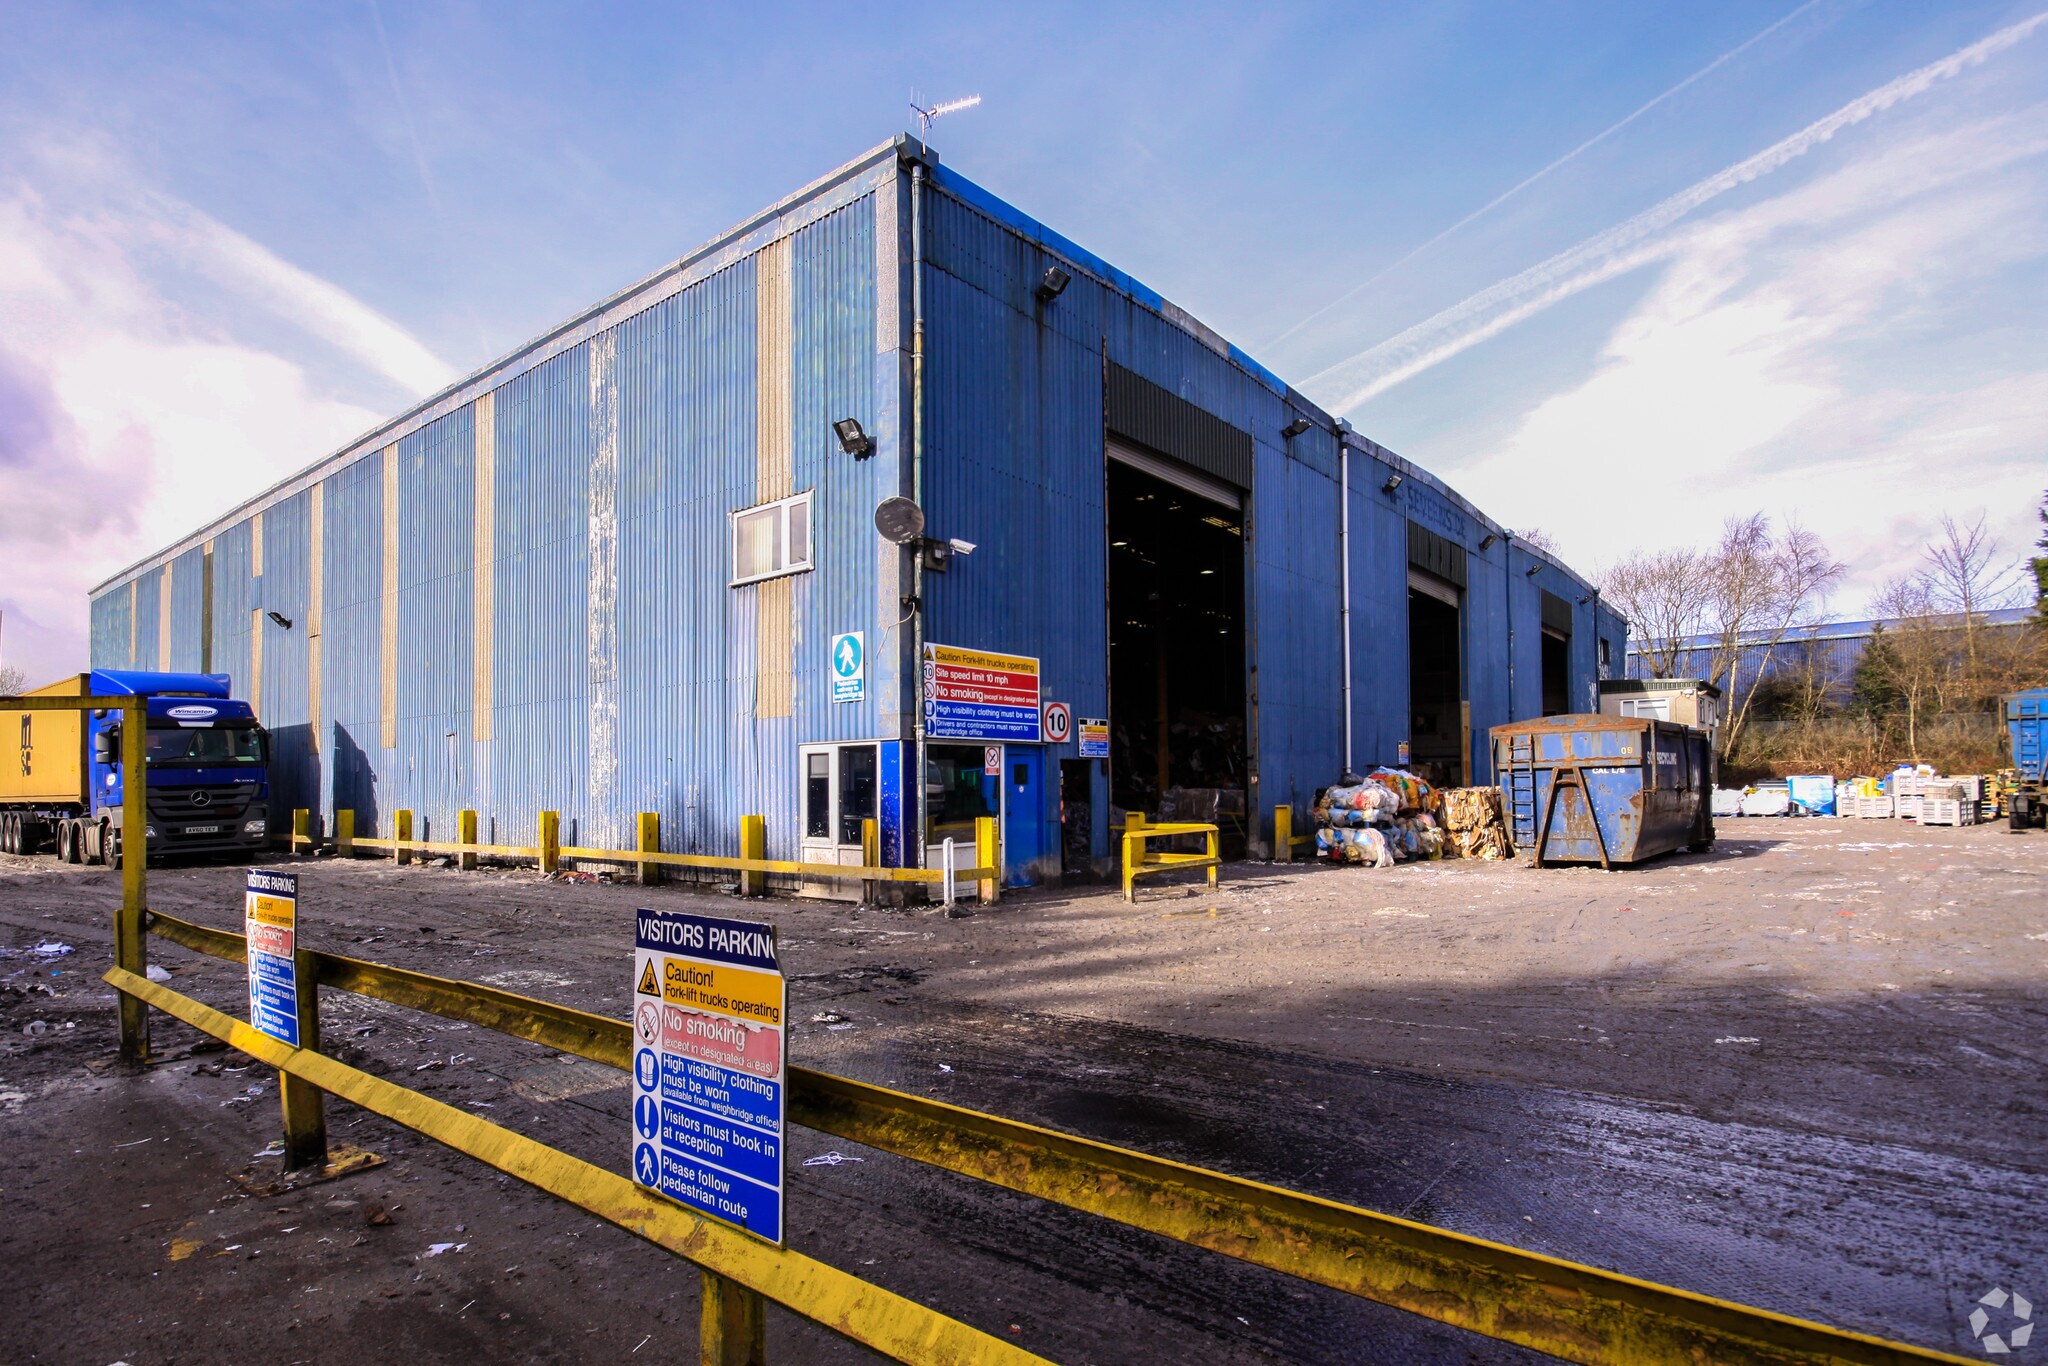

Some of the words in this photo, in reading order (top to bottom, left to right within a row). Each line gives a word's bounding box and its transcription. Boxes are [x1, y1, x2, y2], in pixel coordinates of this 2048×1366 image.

[924, 667, 932, 677] 10
[935, 650, 960, 663] Caution
[962, 654, 985, 665] Fork-lift
[987, 659, 1006, 668] trucks
[1007, 662, 1034, 673] operating
[936, 667, 949, 678] Site
[950, 670, 970, 680] speed
[972, 672, 985, 681] limit
[986, 674, 993, 682] 10
[994, 675, 1008, 685] mph
[936, 685, 948, 697] No
[950, 687, 983, 702] smoking
[936, 704, 950, 714] High
[952, 706, 975, 716] visibility
[977, 709, 999, 718] clothing
[1000, 710, 1015, 718] must
[936, 719, 954, 727] Drivers
[1049, 713, 1066, 732] 10
[936, 728, 967, 736] weighbridge
[969, 728, 983, 736] office
[1620, 746, 1633, 755] 09
[247, 873, 270, 890] VISITORS
[271, 876, 295, 893] PARKING
[638, 917, 704, 949] VISITORS
[665, 962, 714, 988] Caution!
[665, 983, 697, 1002] Fork-lift
[700, 990, 728, 1009] trucks
[731, 999, 779, 1023] operating
[664, 1009, 682, 1032] No
[686, 1018, 746, 1052] smoking
[663, 1036, 690, 1053] (except
[691, 1041, 698, 1054] in
[700, 1045, 745, 1065] designated
[746, 1058, 773, 1075] areas)
[663, 1053, 684, 1074] High
[687, 1062, 727, 1087] visibility
[730, 1074, 773, 1101] clothing
[663, 1073, 686, 1089] must
[689, 1077, 701, 1094] be
[704, 1085, 730, 1102] worn
[663, 1086, 692, 1102] (available
[694, 1094, 709, 1108] from
[711, 1100, 753, 1122] weighbridge
[755, 1113, 779, 1132] office)
[663, 1107, 700, 1132] Visitors
[703, 1123, 729, 1143] must
[732, 1130, 760, 1153] book
[764, 1140, 775, 1158] in
[663, 1126, 672, 1139] at
[675, 1131, 723, 1158] reception
[663, 1155, 695, 1181] Please
[698, 1169, 730, 1194] follow
[663, 1175, 715, 1206] pedestrian
[718, 1197, 748, 1219] route
